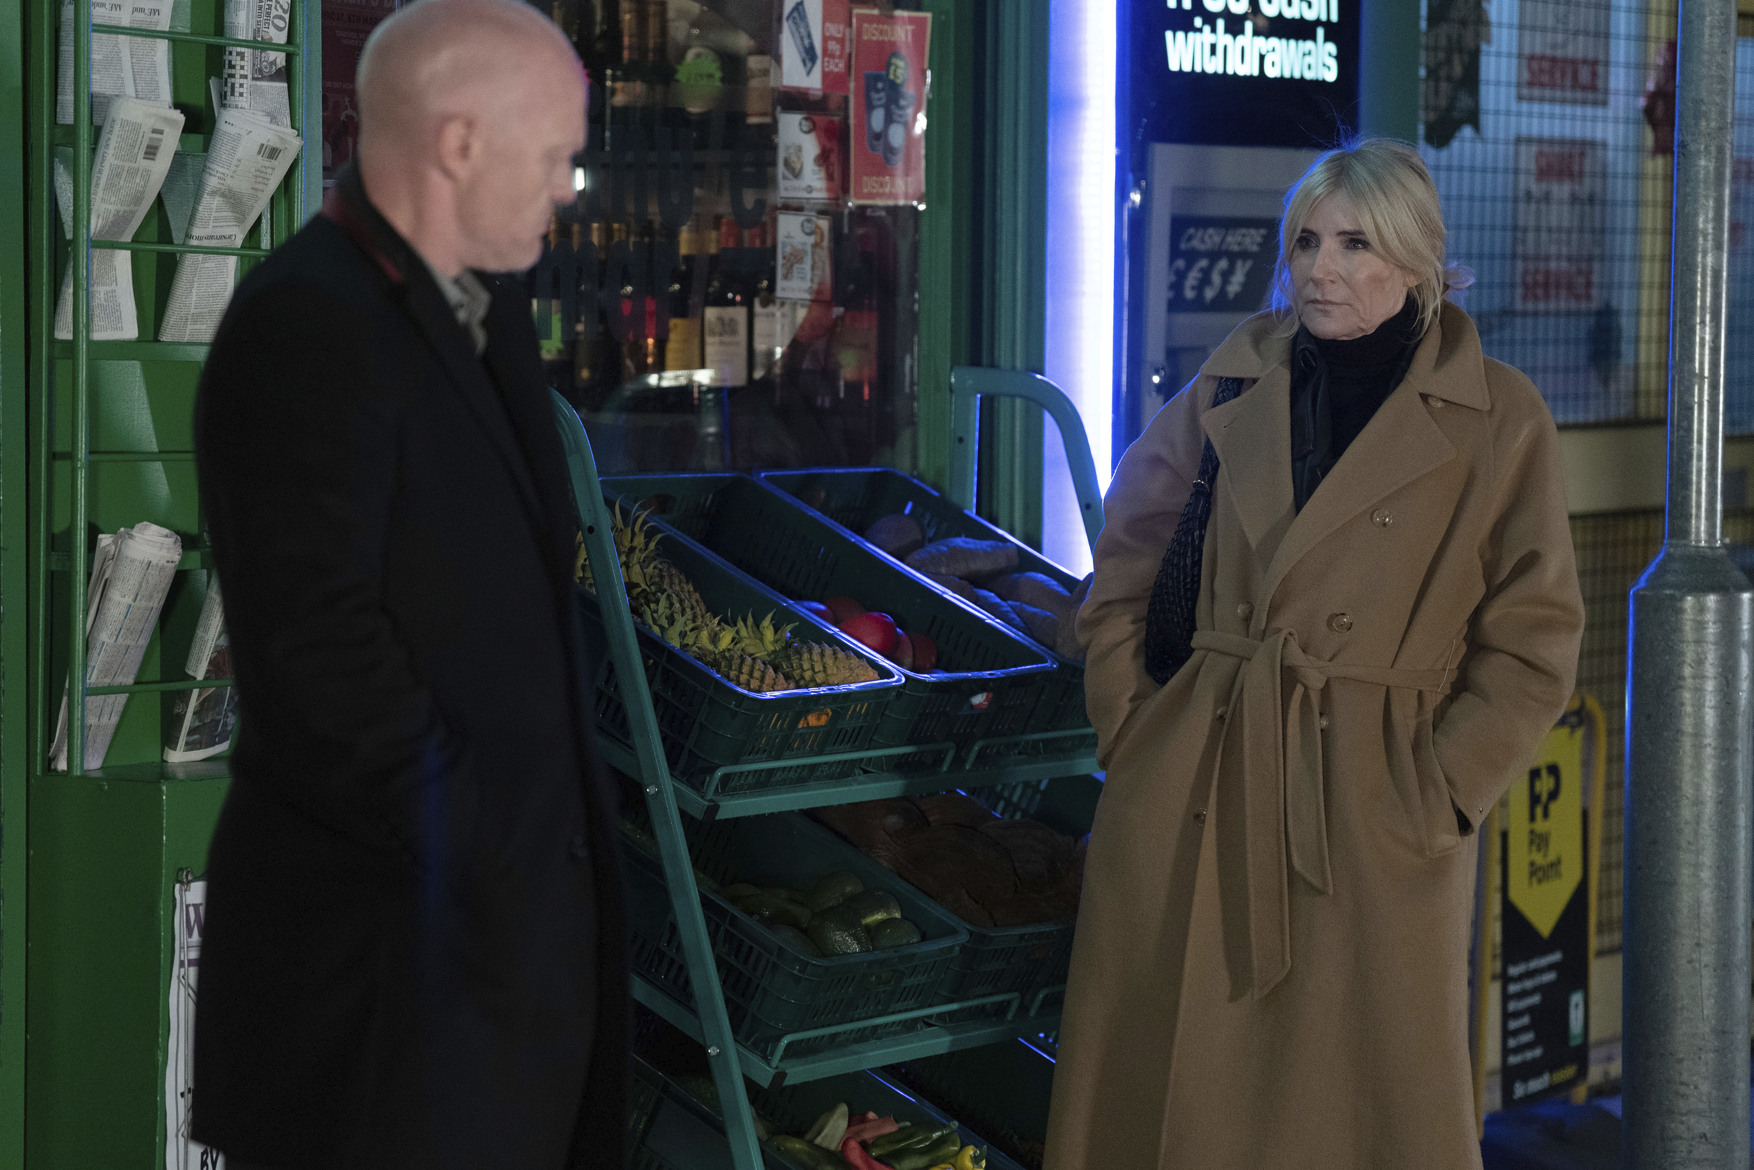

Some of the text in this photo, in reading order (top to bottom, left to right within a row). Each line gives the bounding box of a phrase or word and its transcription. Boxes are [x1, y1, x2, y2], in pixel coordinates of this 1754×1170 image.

[823, 22, 845, 38] ONLY
[861, 23, 916, 42] DISCOUNT
[1164, 16, 1339, 83] withdrawals
[823, 57, 845, 72] EACH
[1179, 227, 1269, 252] CASH HERE
[1528, 828, 1551, 857] Pay
[1528, 855, 1563, 887] Point
